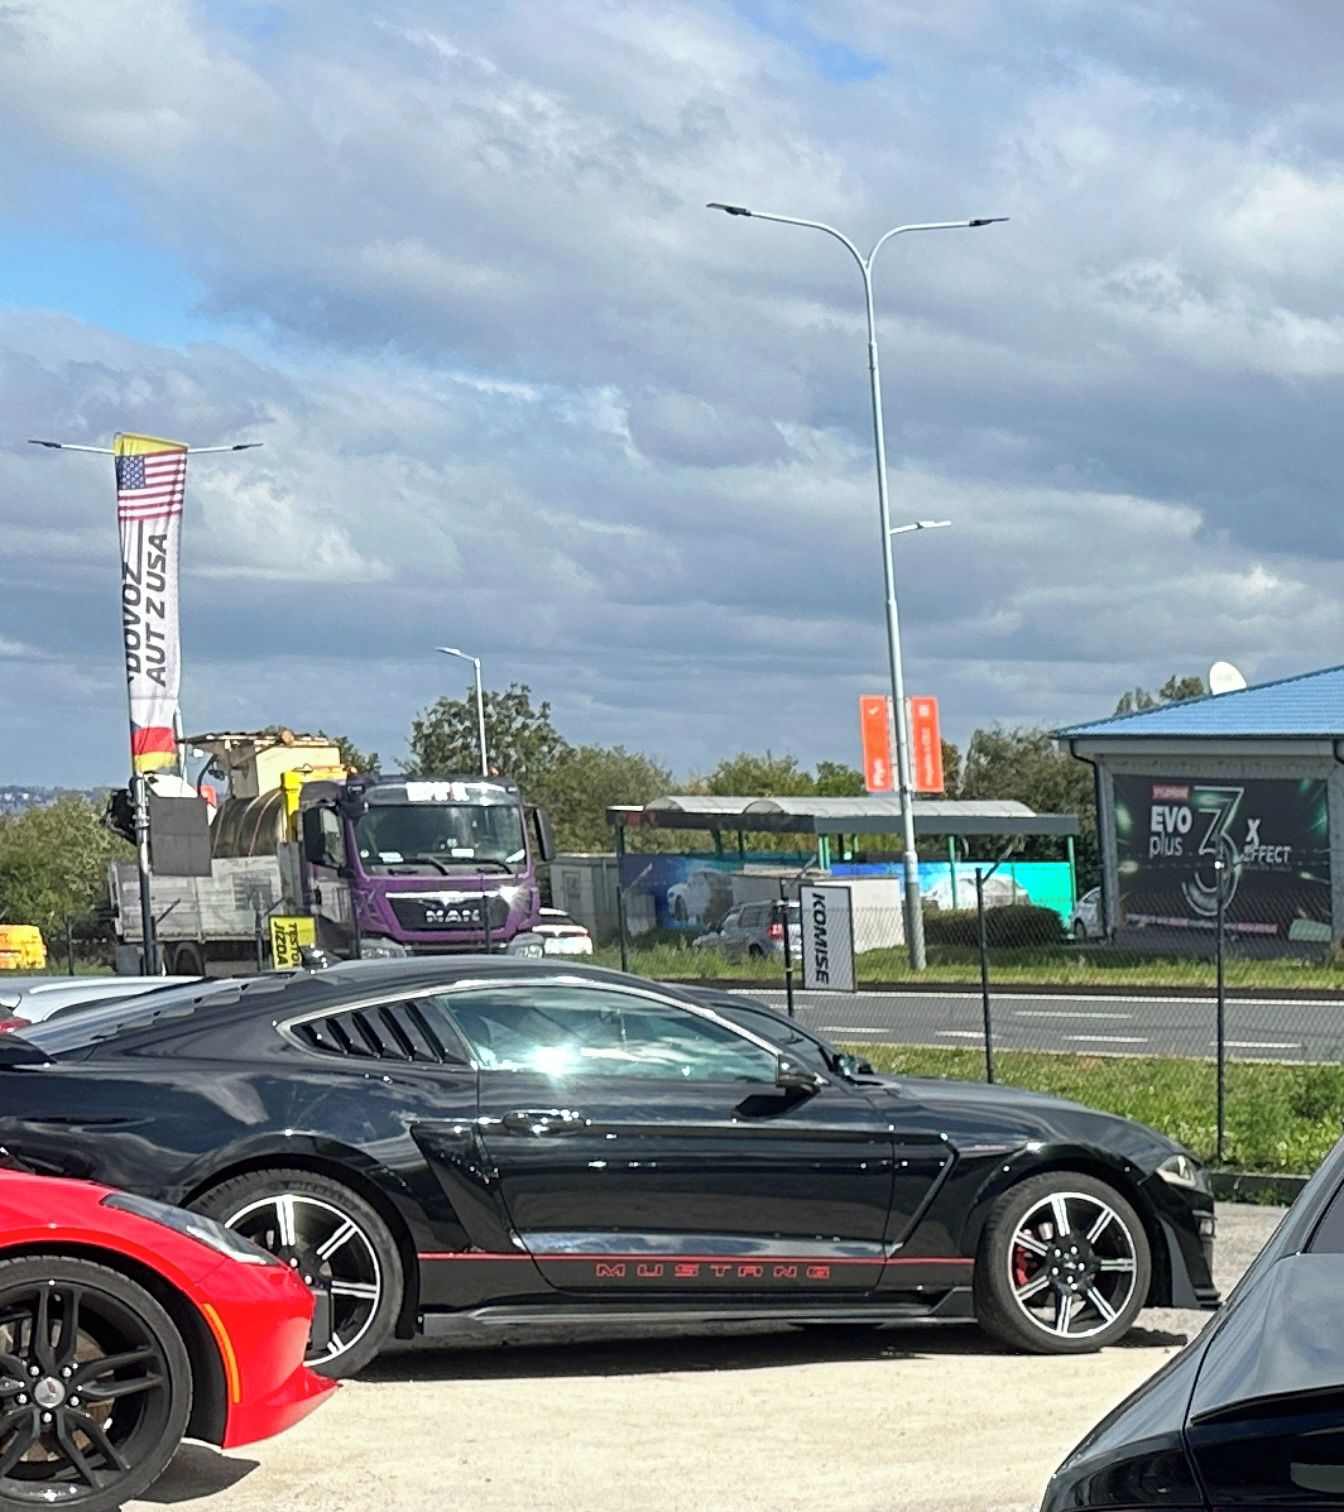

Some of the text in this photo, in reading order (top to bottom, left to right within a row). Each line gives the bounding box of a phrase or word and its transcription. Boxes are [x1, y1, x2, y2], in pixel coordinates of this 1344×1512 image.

[145, 533, 168, 688] AUT Z USA
[1150, 805, 1193, 834] EVO
[1149, 832, 1184, 860] plus
[1243, 845, 1293, 864] EFFECT
[426, 910, 480, 923] MAN
[812, 893, 829, 984] KOMISE
[596, 1263, 830, 1279] MUSTANG
